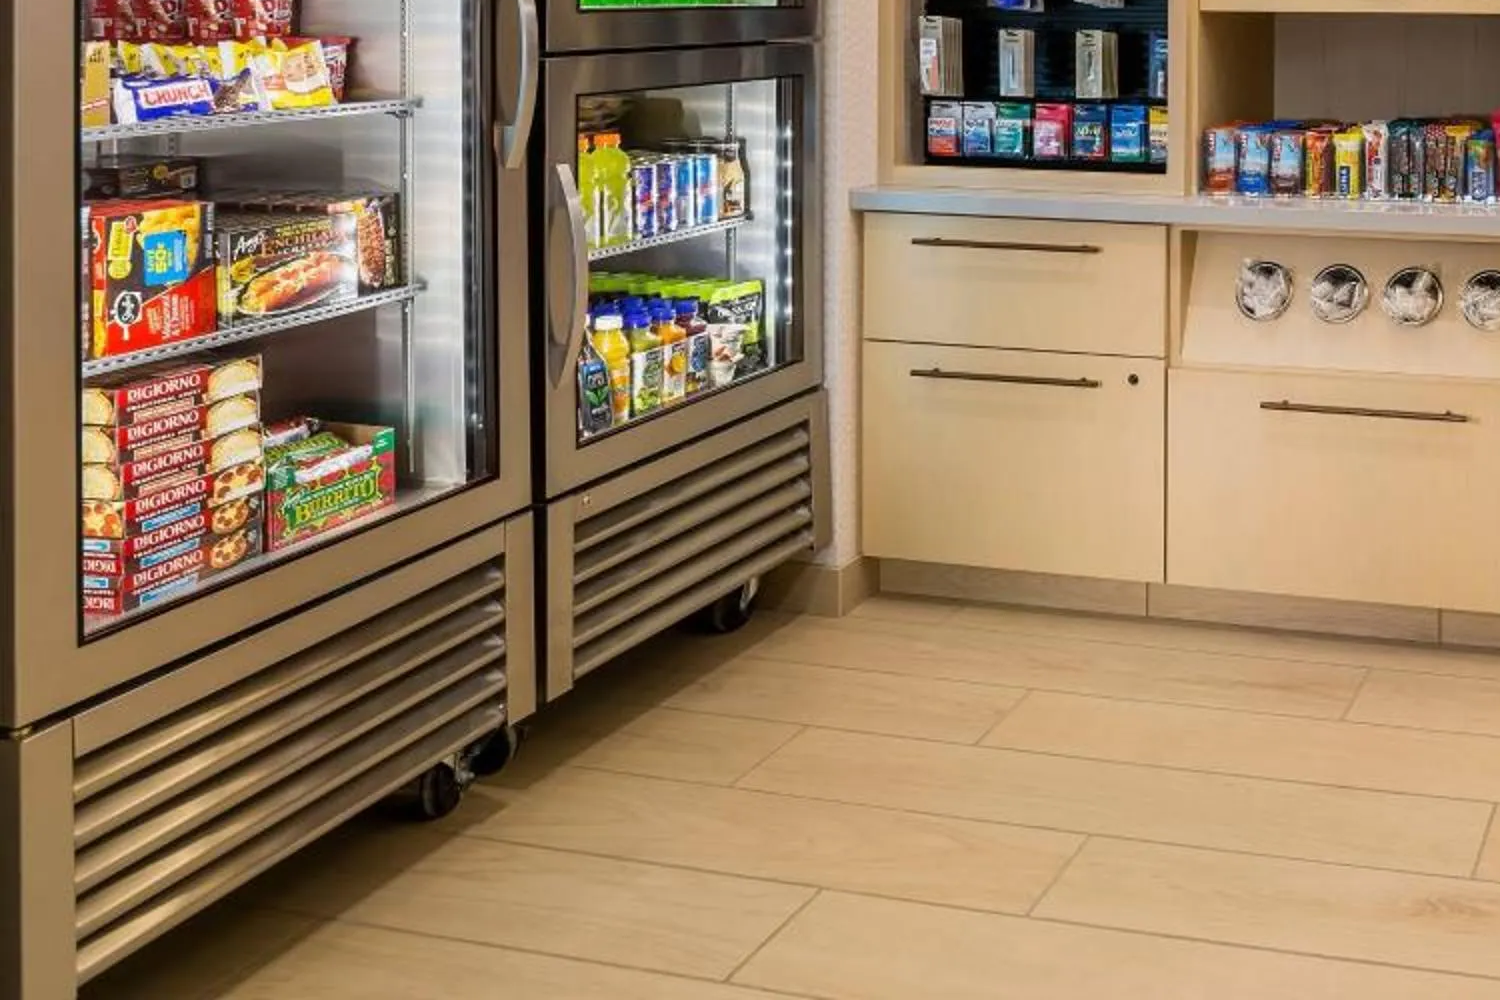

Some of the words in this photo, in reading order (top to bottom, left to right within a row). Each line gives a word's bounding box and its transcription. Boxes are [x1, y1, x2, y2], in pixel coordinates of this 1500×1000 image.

[128, 373, 200, 400] DIGIORNO
[128, 410, 199, 440] DIGIORNO
[132, 445, 203, 474] DIGIORNO
[135, 480, 206, 512] DIGIORNO
[134, 515, 204, 548] DIGIORNO
[134, 550, 203, 585] DIGIORNO
